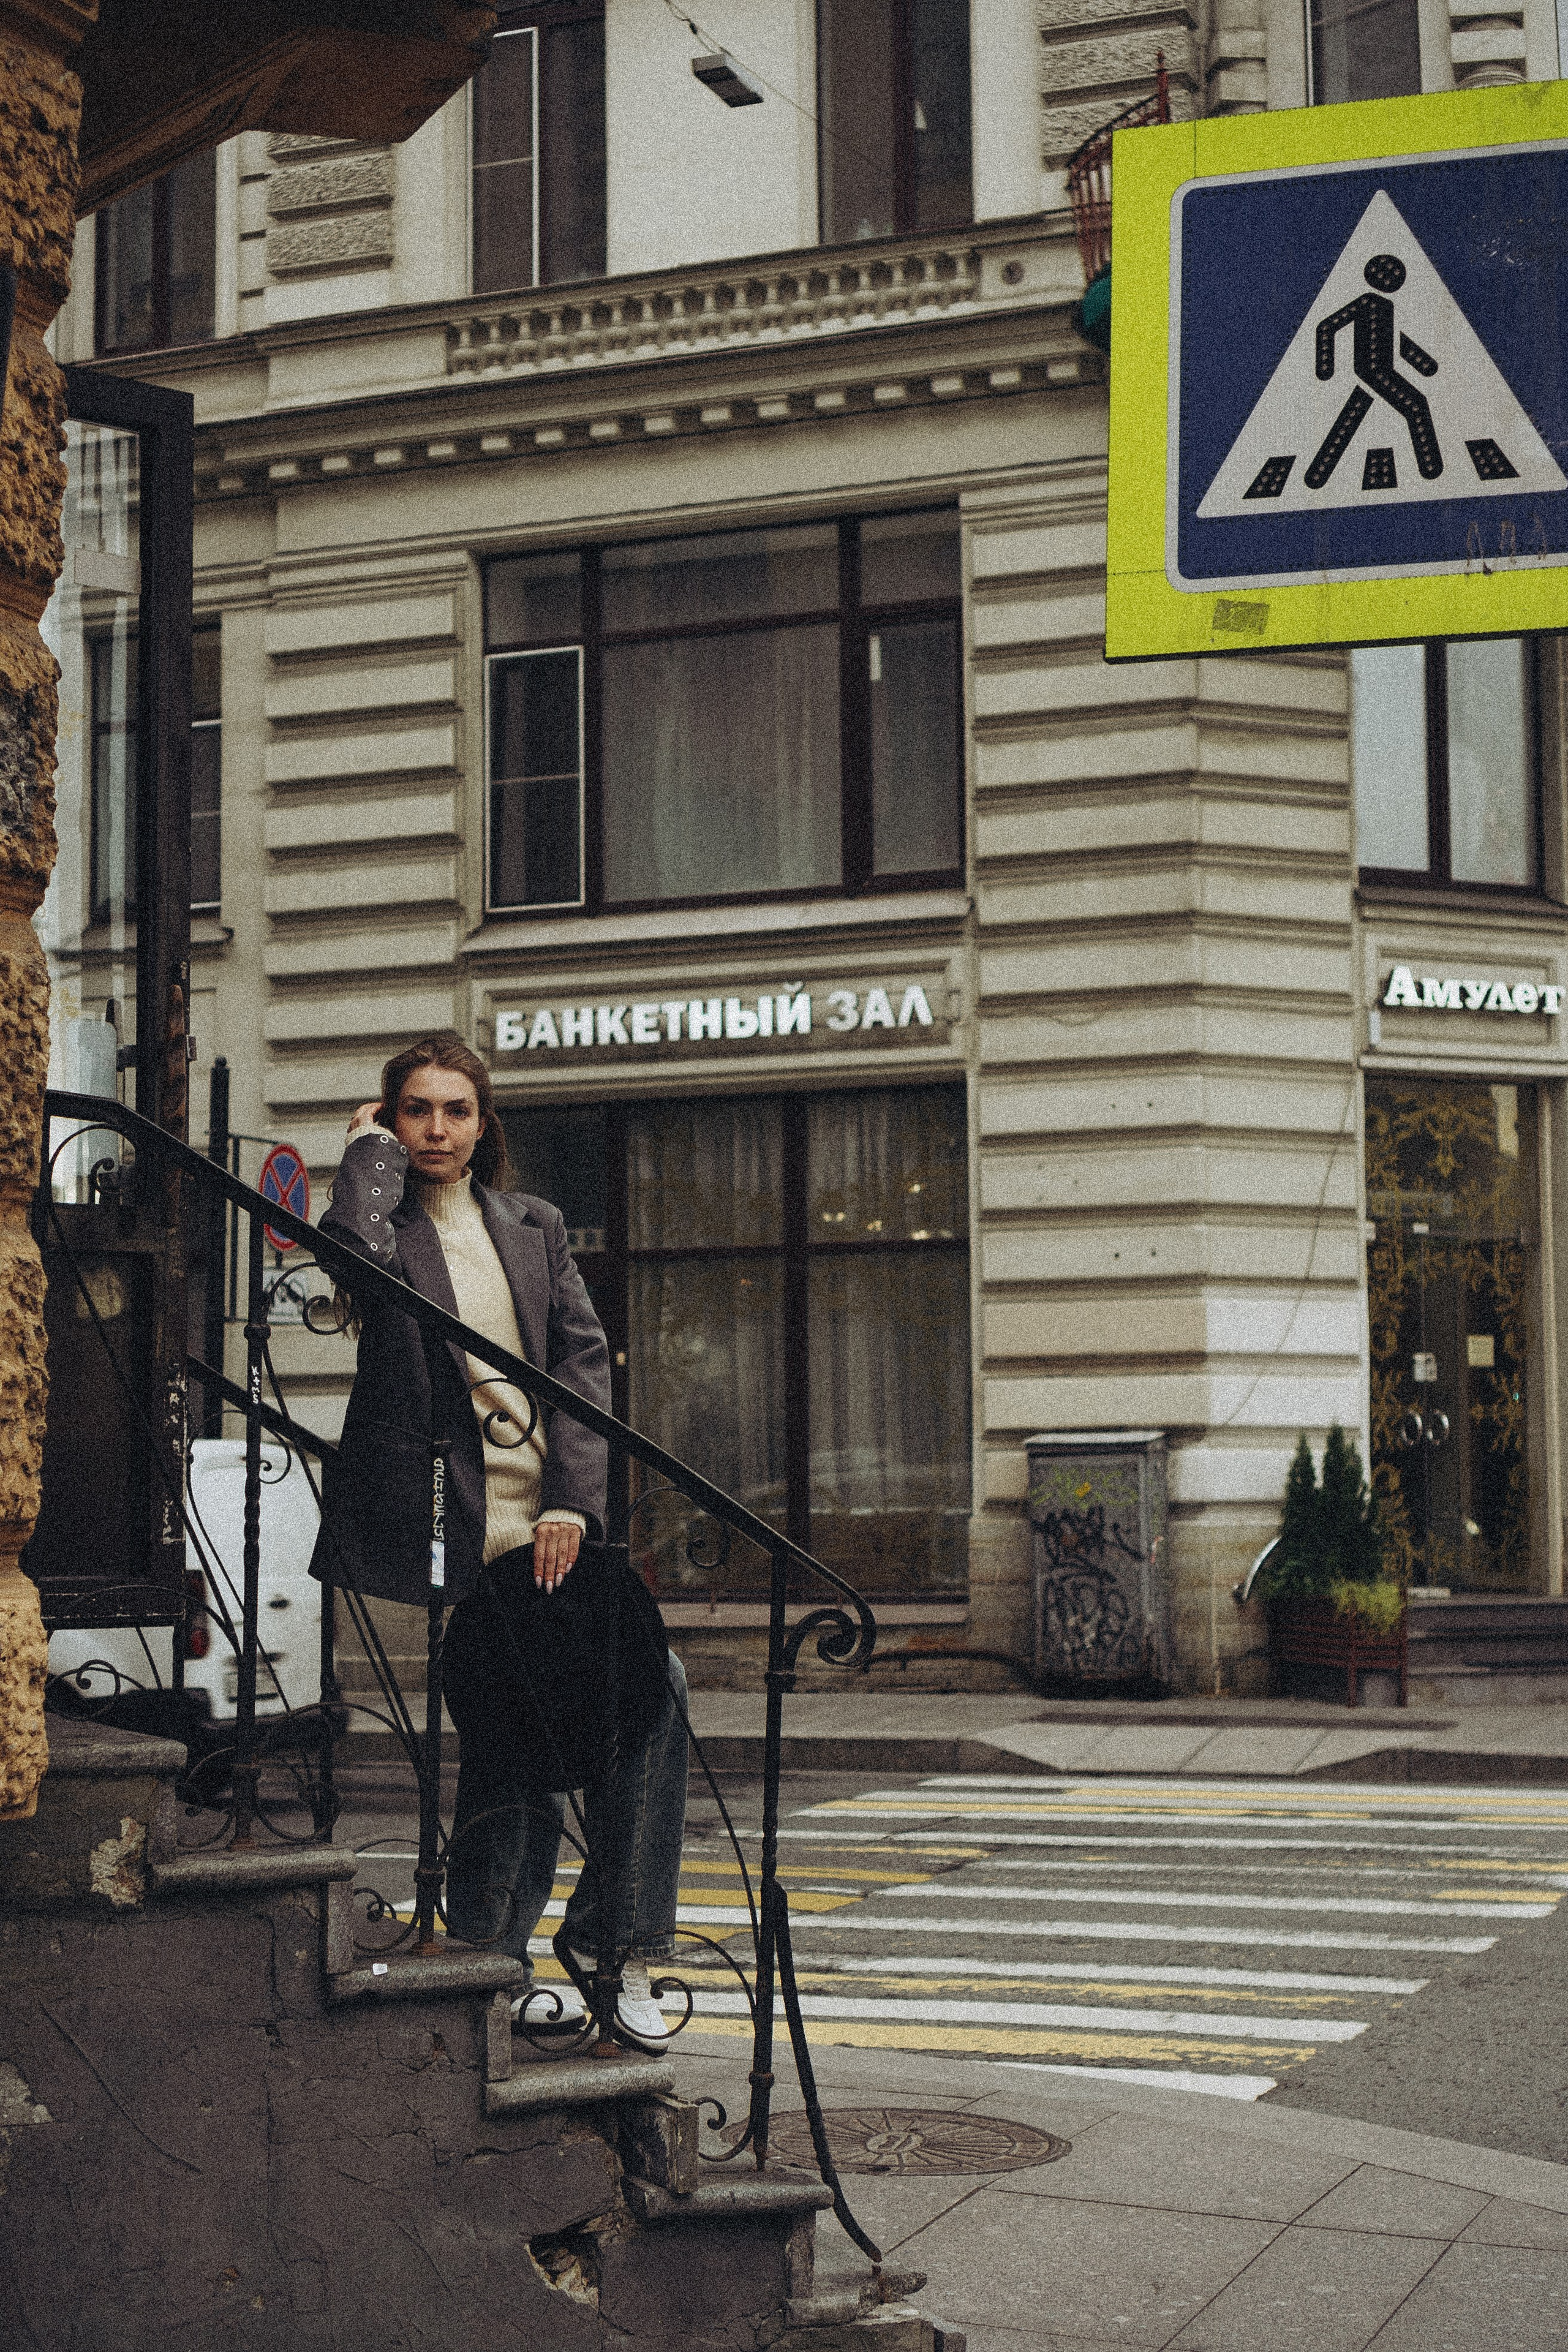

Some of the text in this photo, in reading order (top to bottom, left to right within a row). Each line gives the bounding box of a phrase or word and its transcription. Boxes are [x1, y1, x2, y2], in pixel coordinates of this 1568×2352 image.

[495, 982, 934, 1050] БАНКЕТНЫЙ ЗАЛ
[1384, 965, 1566, 1014] Амулет
